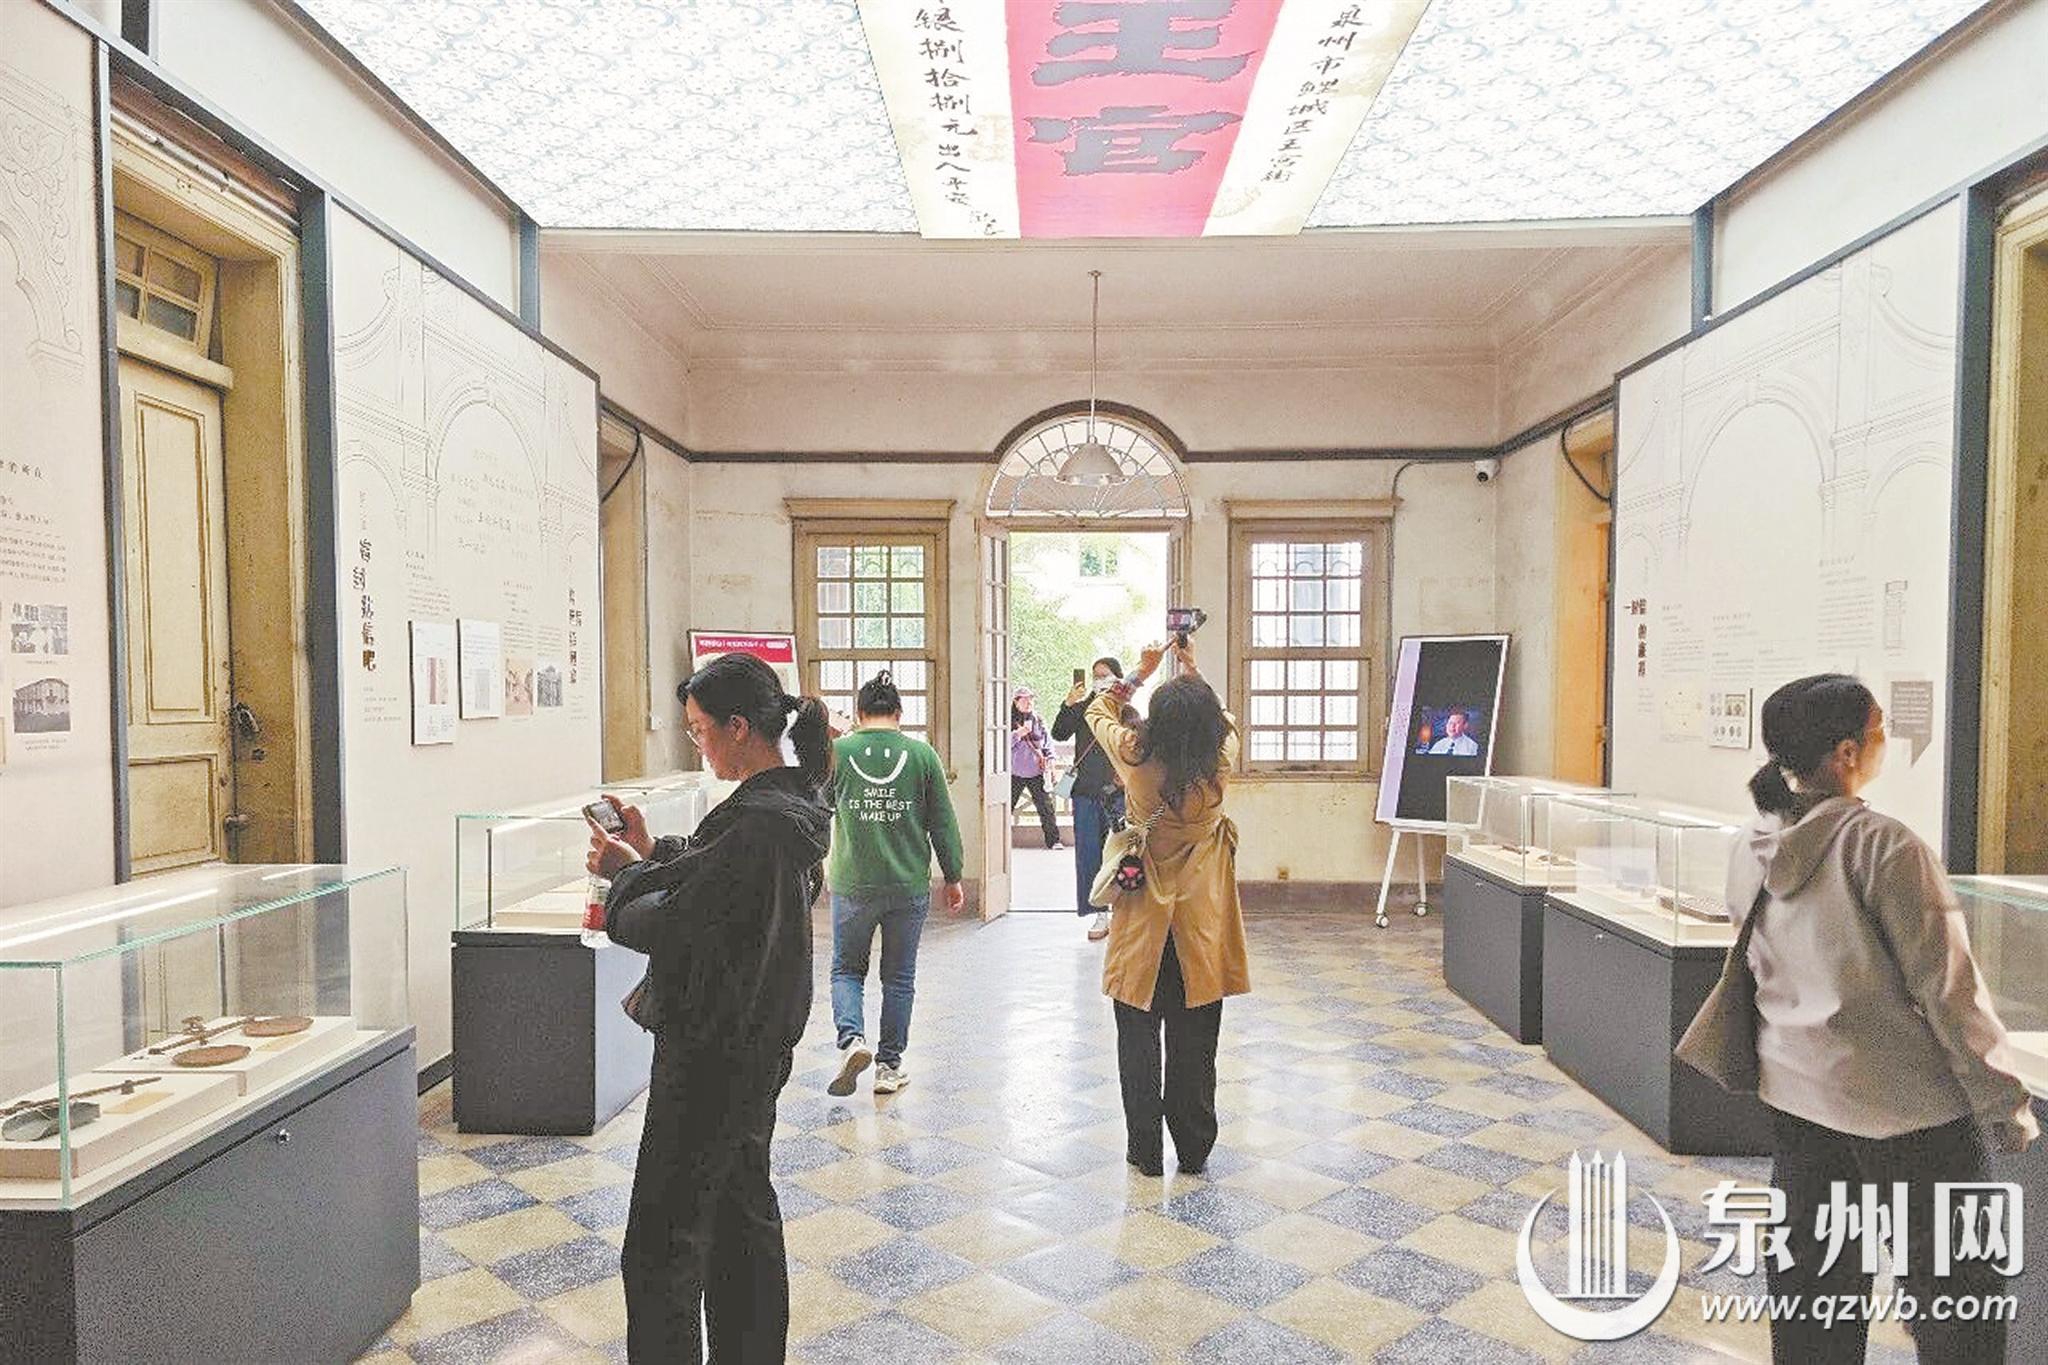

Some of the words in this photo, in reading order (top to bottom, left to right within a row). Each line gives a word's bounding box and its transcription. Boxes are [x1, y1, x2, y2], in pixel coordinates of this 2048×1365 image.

[863, 786, 897, 799] SMILE
[848, 799, 861, 810] IS
[863, 800, 883, 810] THE
[885, 800, 913, 811] BEST
